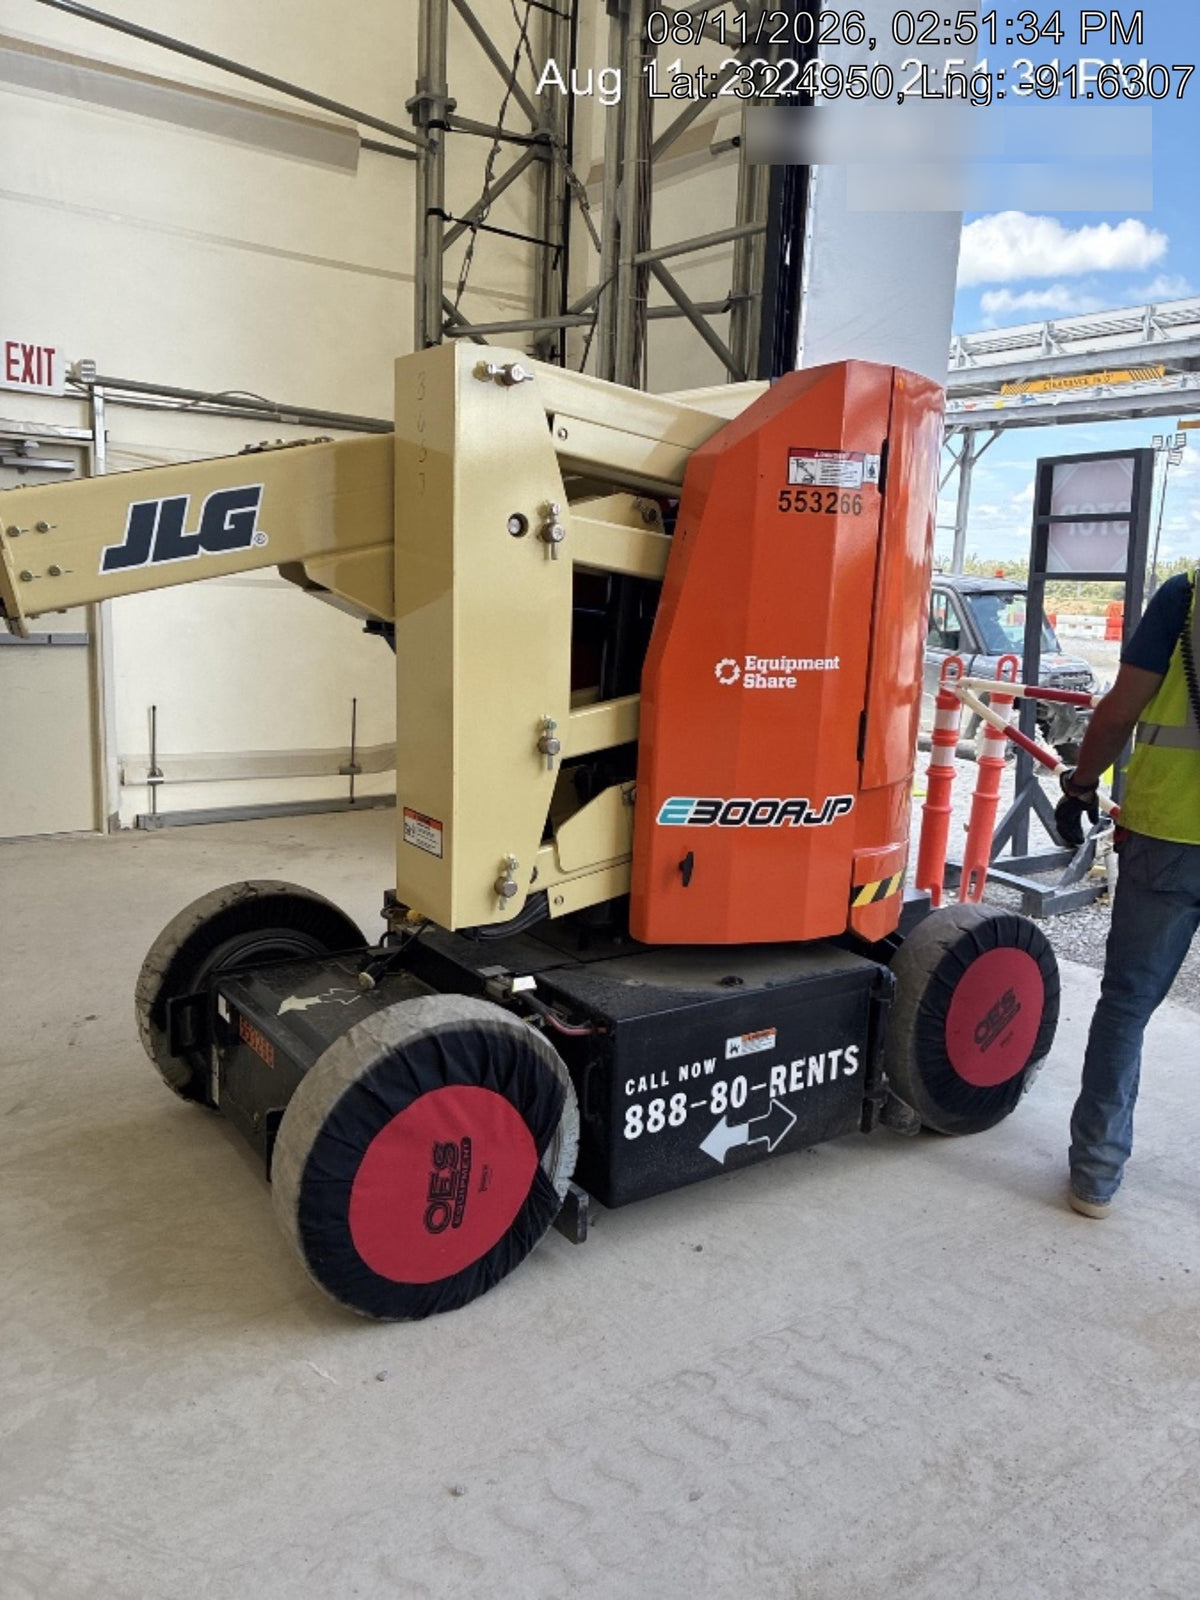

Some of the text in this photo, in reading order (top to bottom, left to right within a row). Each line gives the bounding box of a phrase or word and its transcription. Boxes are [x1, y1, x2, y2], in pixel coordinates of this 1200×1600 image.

[5, 341, 56, 387] EXIT
[778, 490, 863, 515] 553266
[101, 484, 263, 573] JLG
[743, 673, 797, 689] Share
[744, 655, 840, 674] Equipment
[656, 794, 854, 827] E300AJP
[623, 1044, 861, 1141] 888-80-RENTS
[624, 1057, 717, 1096] CALL NOW
[423, 1141, 459, 1235] OES
